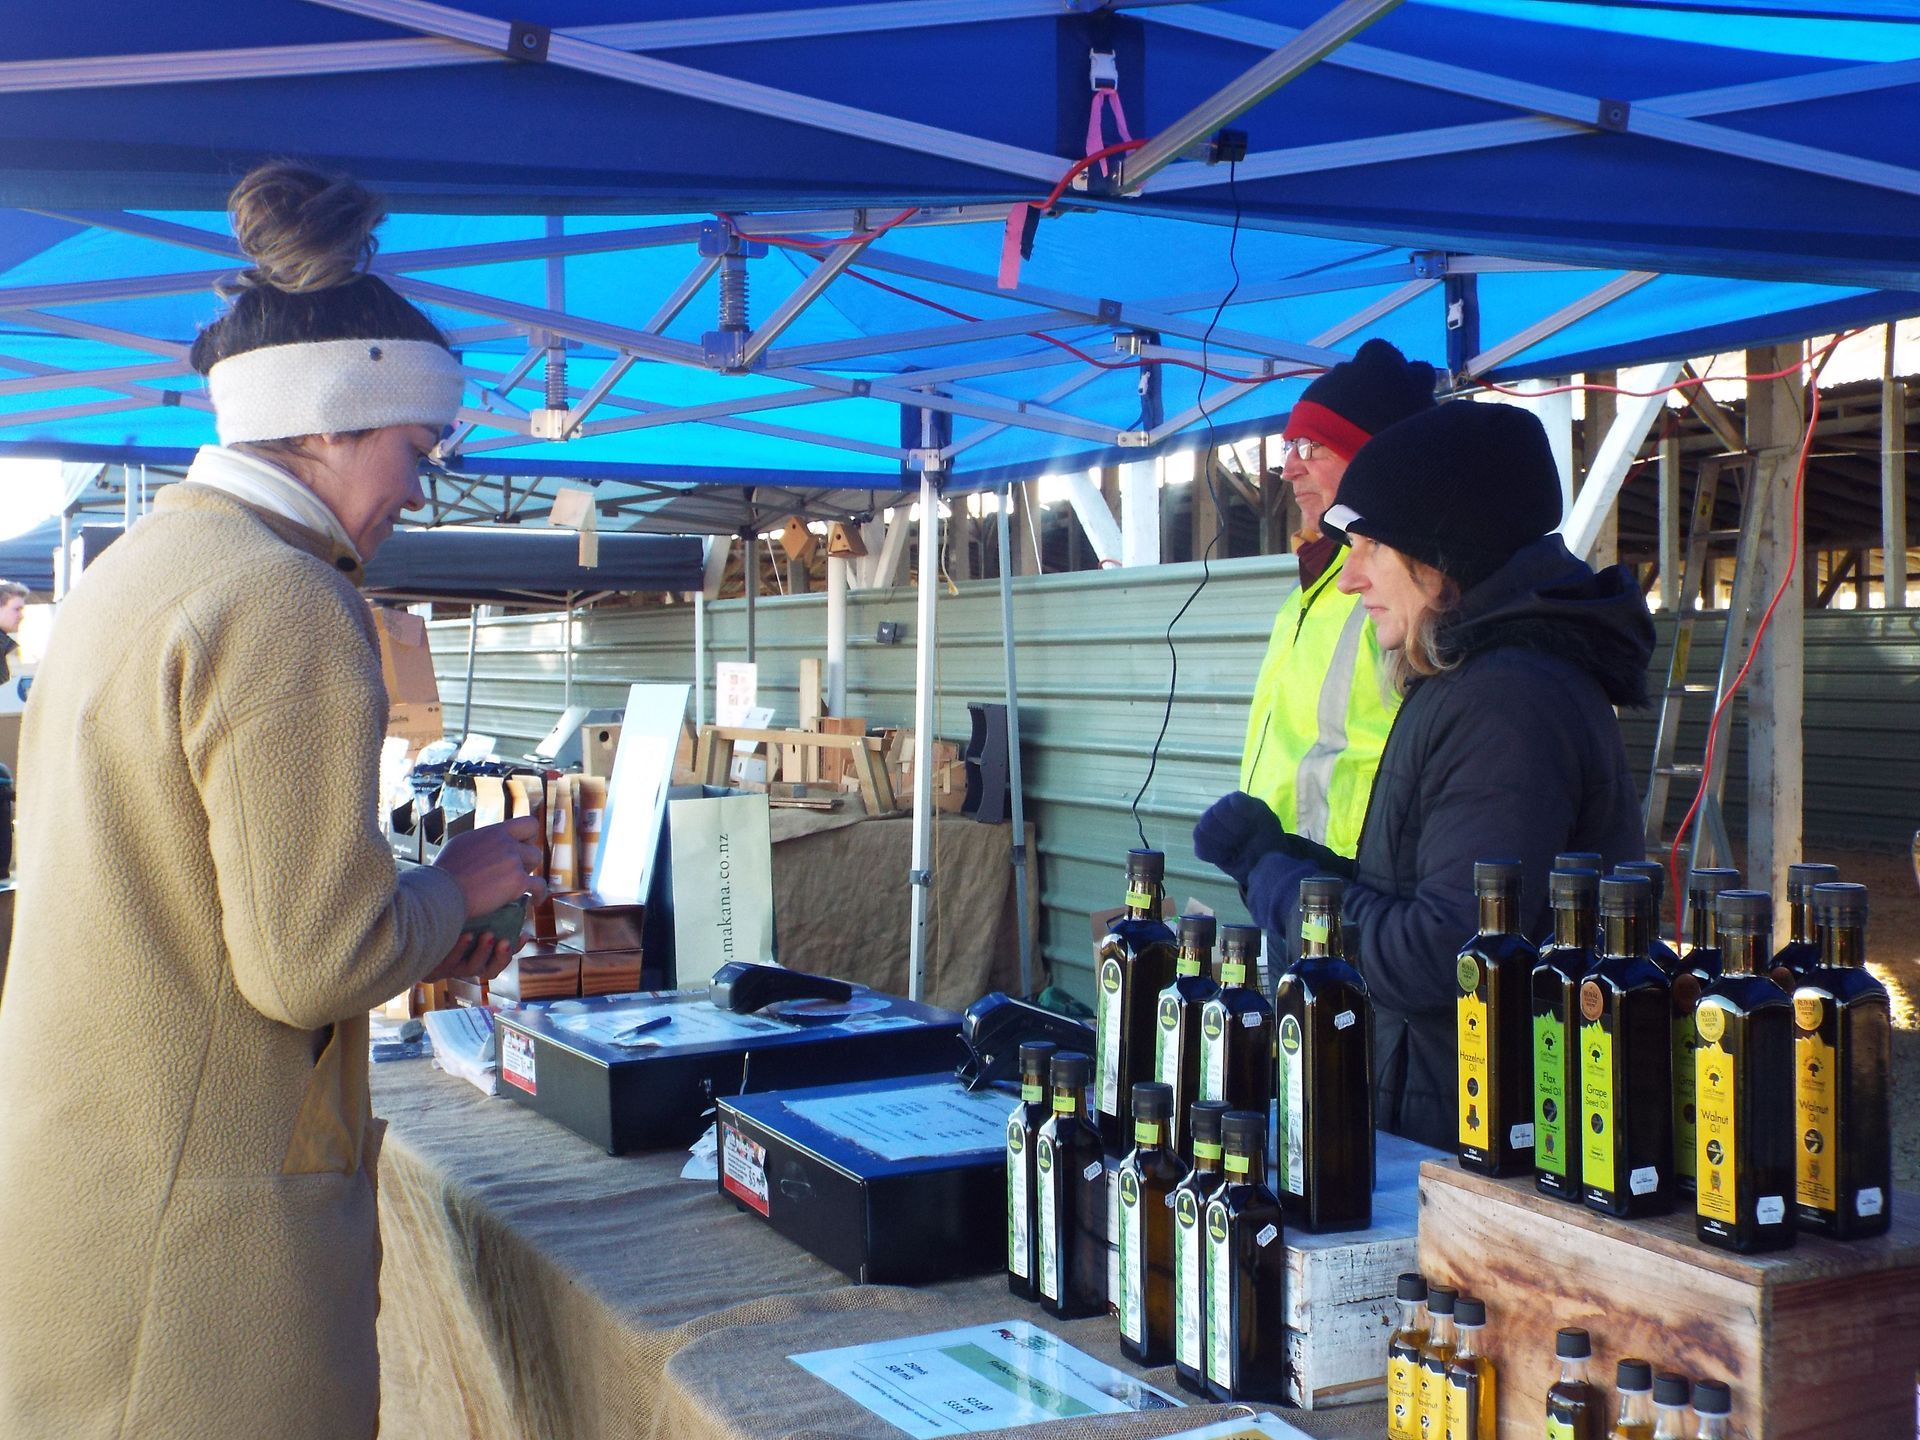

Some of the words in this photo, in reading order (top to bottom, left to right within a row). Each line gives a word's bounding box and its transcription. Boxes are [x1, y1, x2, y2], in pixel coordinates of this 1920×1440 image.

[1459, 1050, 1486, 1065] Hazelnut
[1543, 1071, 1556, 1084] Flax
[1586, 1083, 1607, 1098] Grape
[1700, 1108, 1729, 1125] Walnut
[943, 1400, 974, 1415] $33.00
